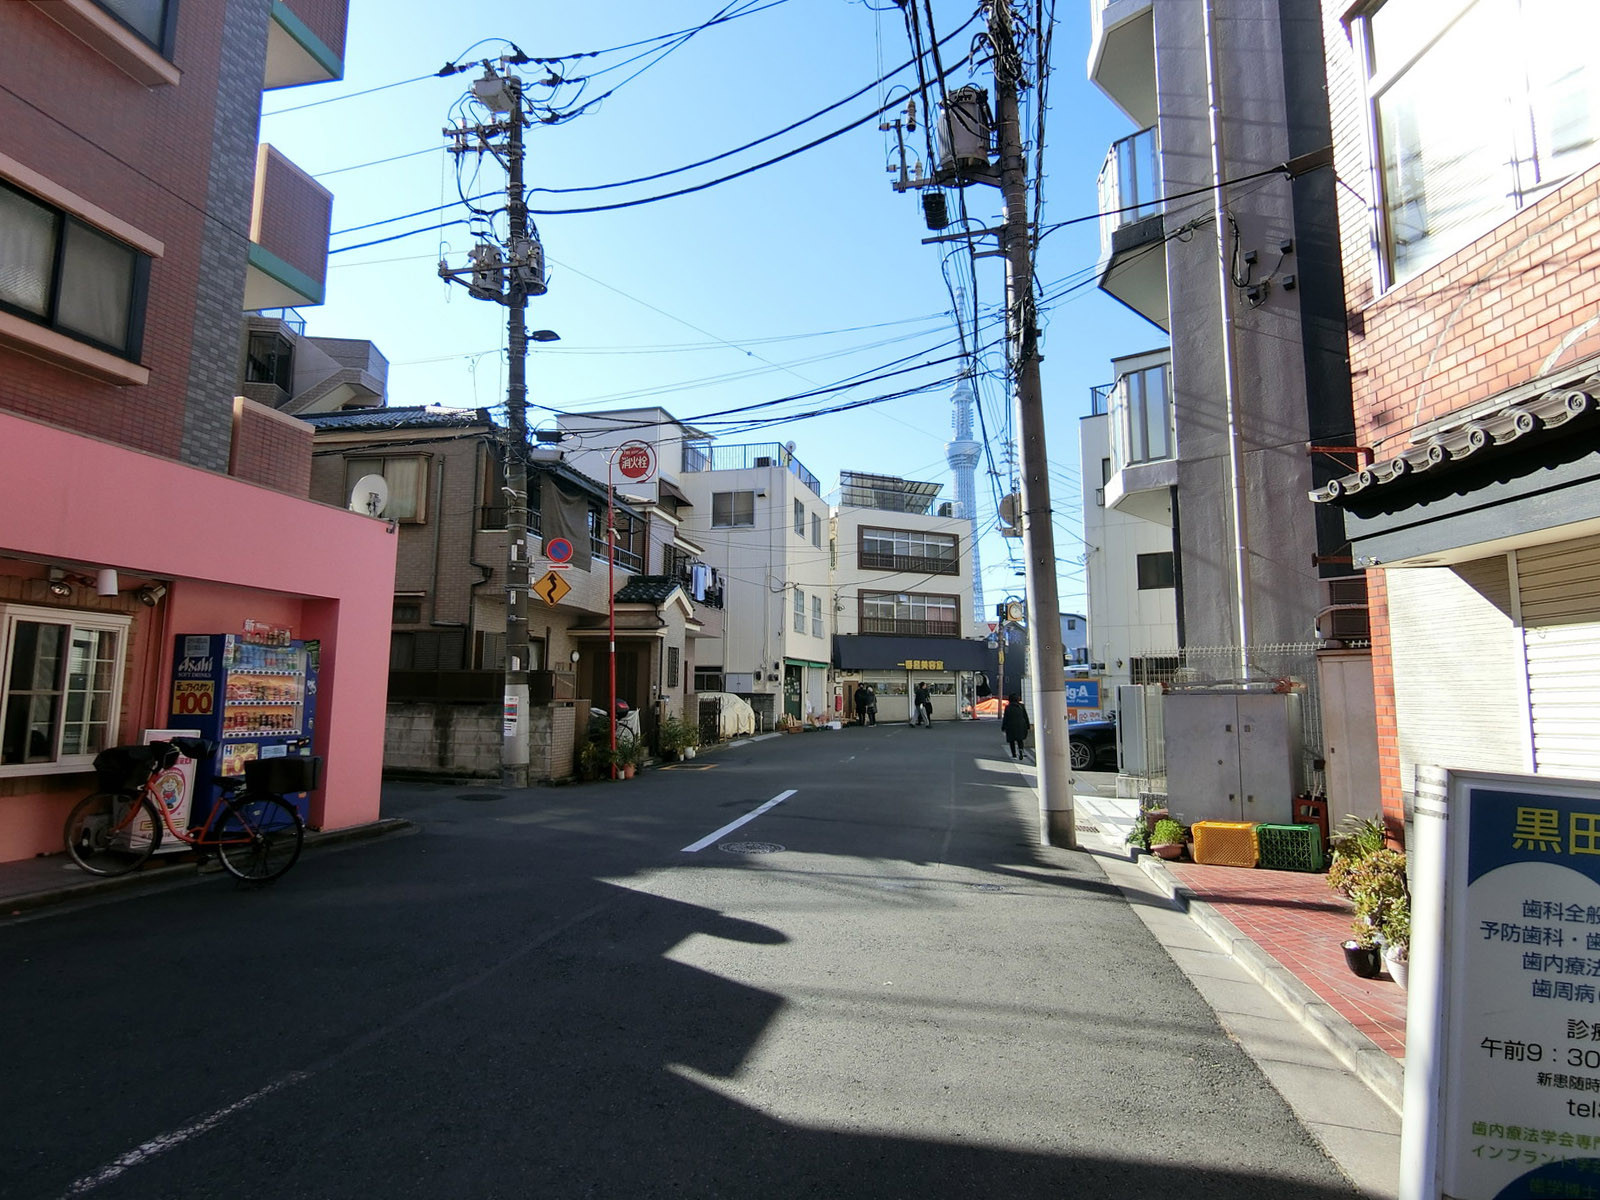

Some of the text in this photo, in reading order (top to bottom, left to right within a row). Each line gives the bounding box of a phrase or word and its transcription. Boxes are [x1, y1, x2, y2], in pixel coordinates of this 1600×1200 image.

[622, 455, 648, 469] 消火栓
[178, 656, 213, 672] Asahi
[176, 692, 213, 714] 100
[1512, 806, 1600, 855] 黒田
[1522, 899, 1600, 925] 歯科全般
[1522, 951, 1600, 977] 歯内療法
